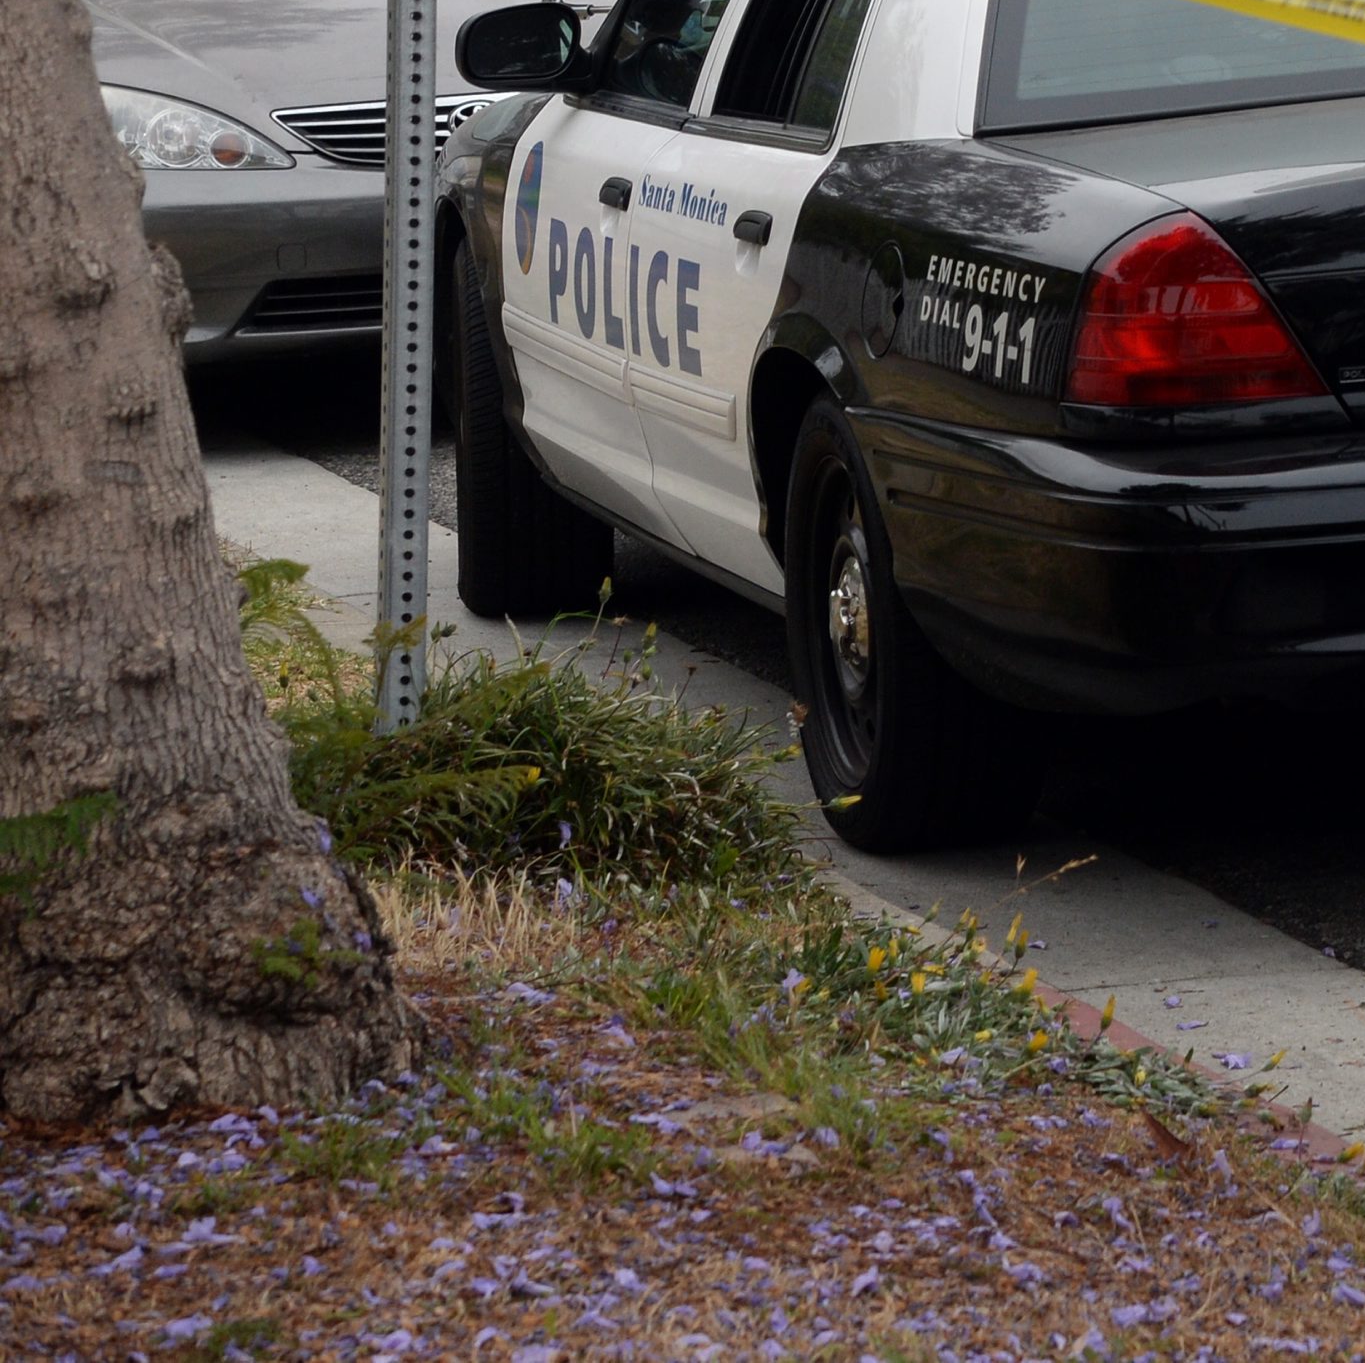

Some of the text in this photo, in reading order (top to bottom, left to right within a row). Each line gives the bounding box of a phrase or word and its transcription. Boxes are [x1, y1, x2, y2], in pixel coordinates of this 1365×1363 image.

[638, 174, 728, 227] Santa Monica
[548, 217, 703, 377] POLICE
[926, 254, 1047, 304] EMERGENCY
[919, 295, 1035, 384] DIAL 9-1-1
